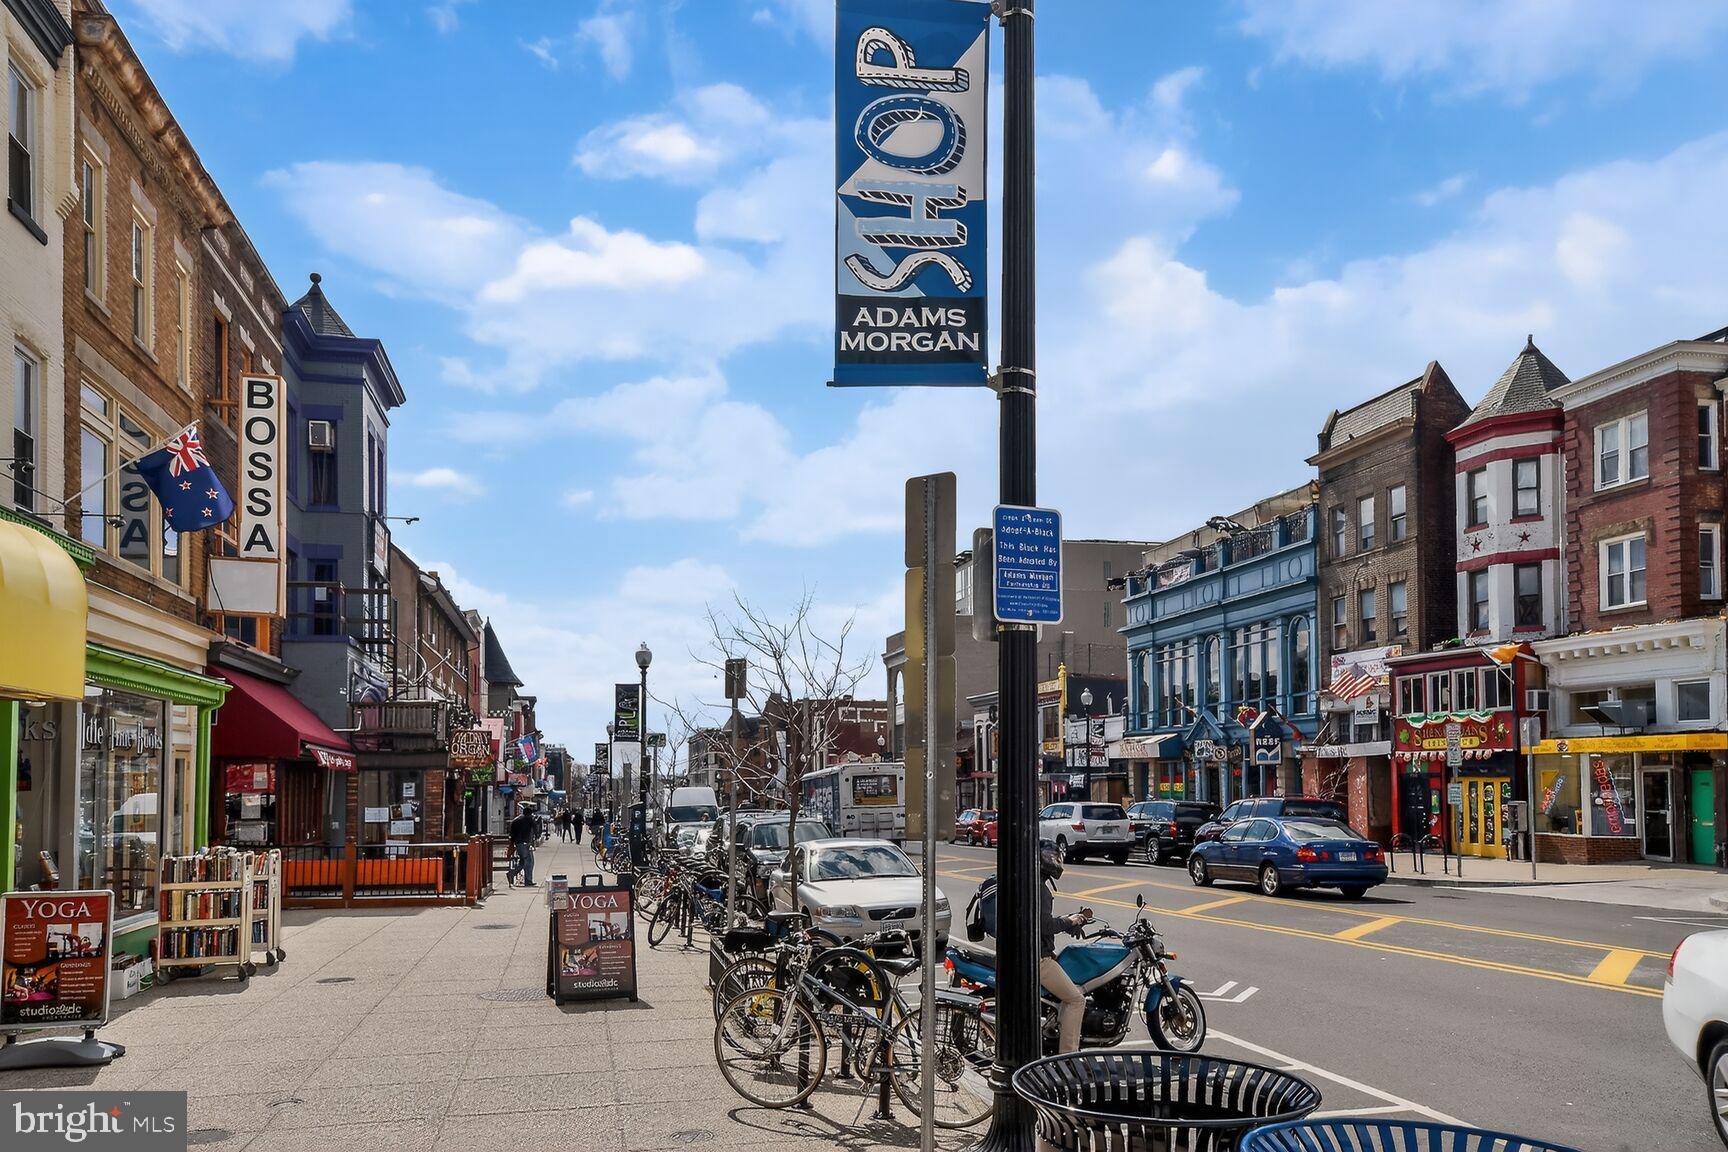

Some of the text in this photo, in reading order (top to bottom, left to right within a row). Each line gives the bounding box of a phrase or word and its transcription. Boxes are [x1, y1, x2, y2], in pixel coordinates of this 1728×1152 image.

[845, 27, 972, 294] SHOP
[853, 307, 966, 328] ADAMS
[840, 331, 979, 352] MORGAN
[243, 380, 276, 553] BOSSA
[1000, 541, 1057, 553] This Block Has
[998, 555, 1057, 567] Been Adopted By
[82, 712, 104, 750] Idle
[451, 743, 490, 755] ORGAN
[21, 900, 92, 919] YOGA
[569, 894, 618, 909] YOGA
